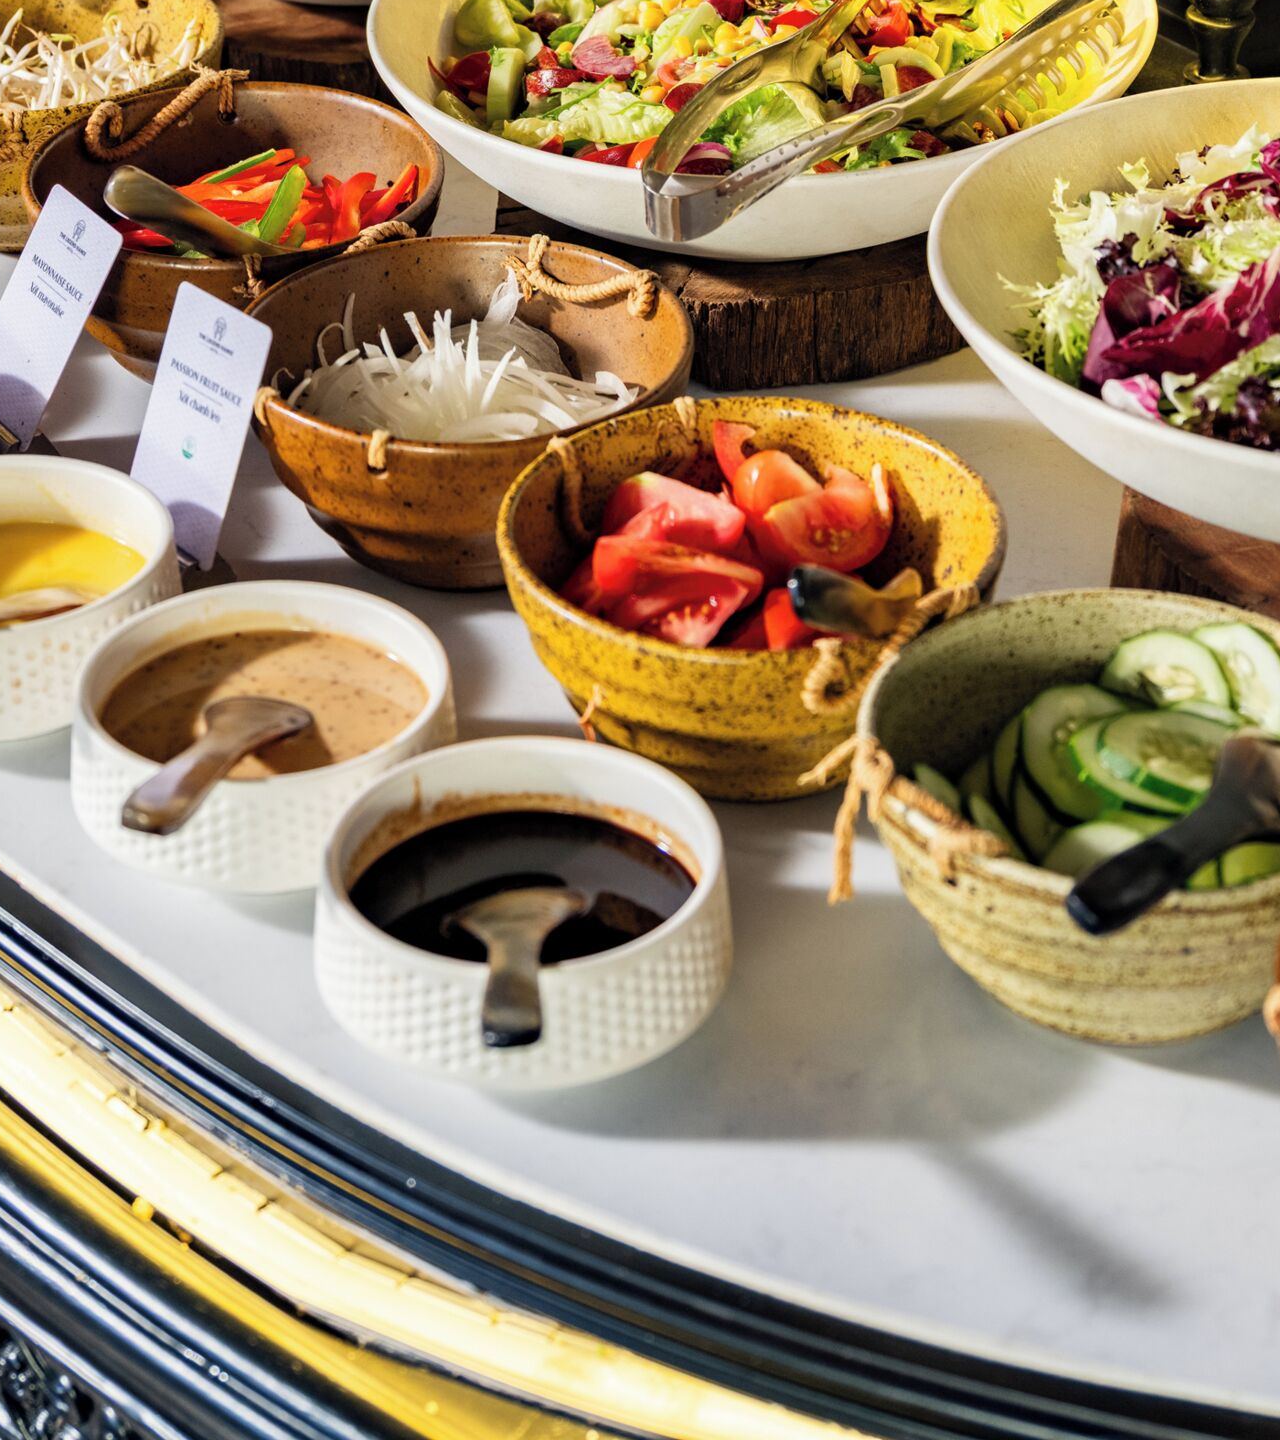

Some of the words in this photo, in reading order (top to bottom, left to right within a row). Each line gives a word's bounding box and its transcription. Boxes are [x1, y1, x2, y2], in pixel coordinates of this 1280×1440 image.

[31, 254, 68, 290] MAYONNAISE
[65, 282, 83, 303] SAUCE
[170, 358, 201, 383] PASSION
[198, 372, 221, 395] FRUIT
[219, 385, 242, 408] SAUCE
